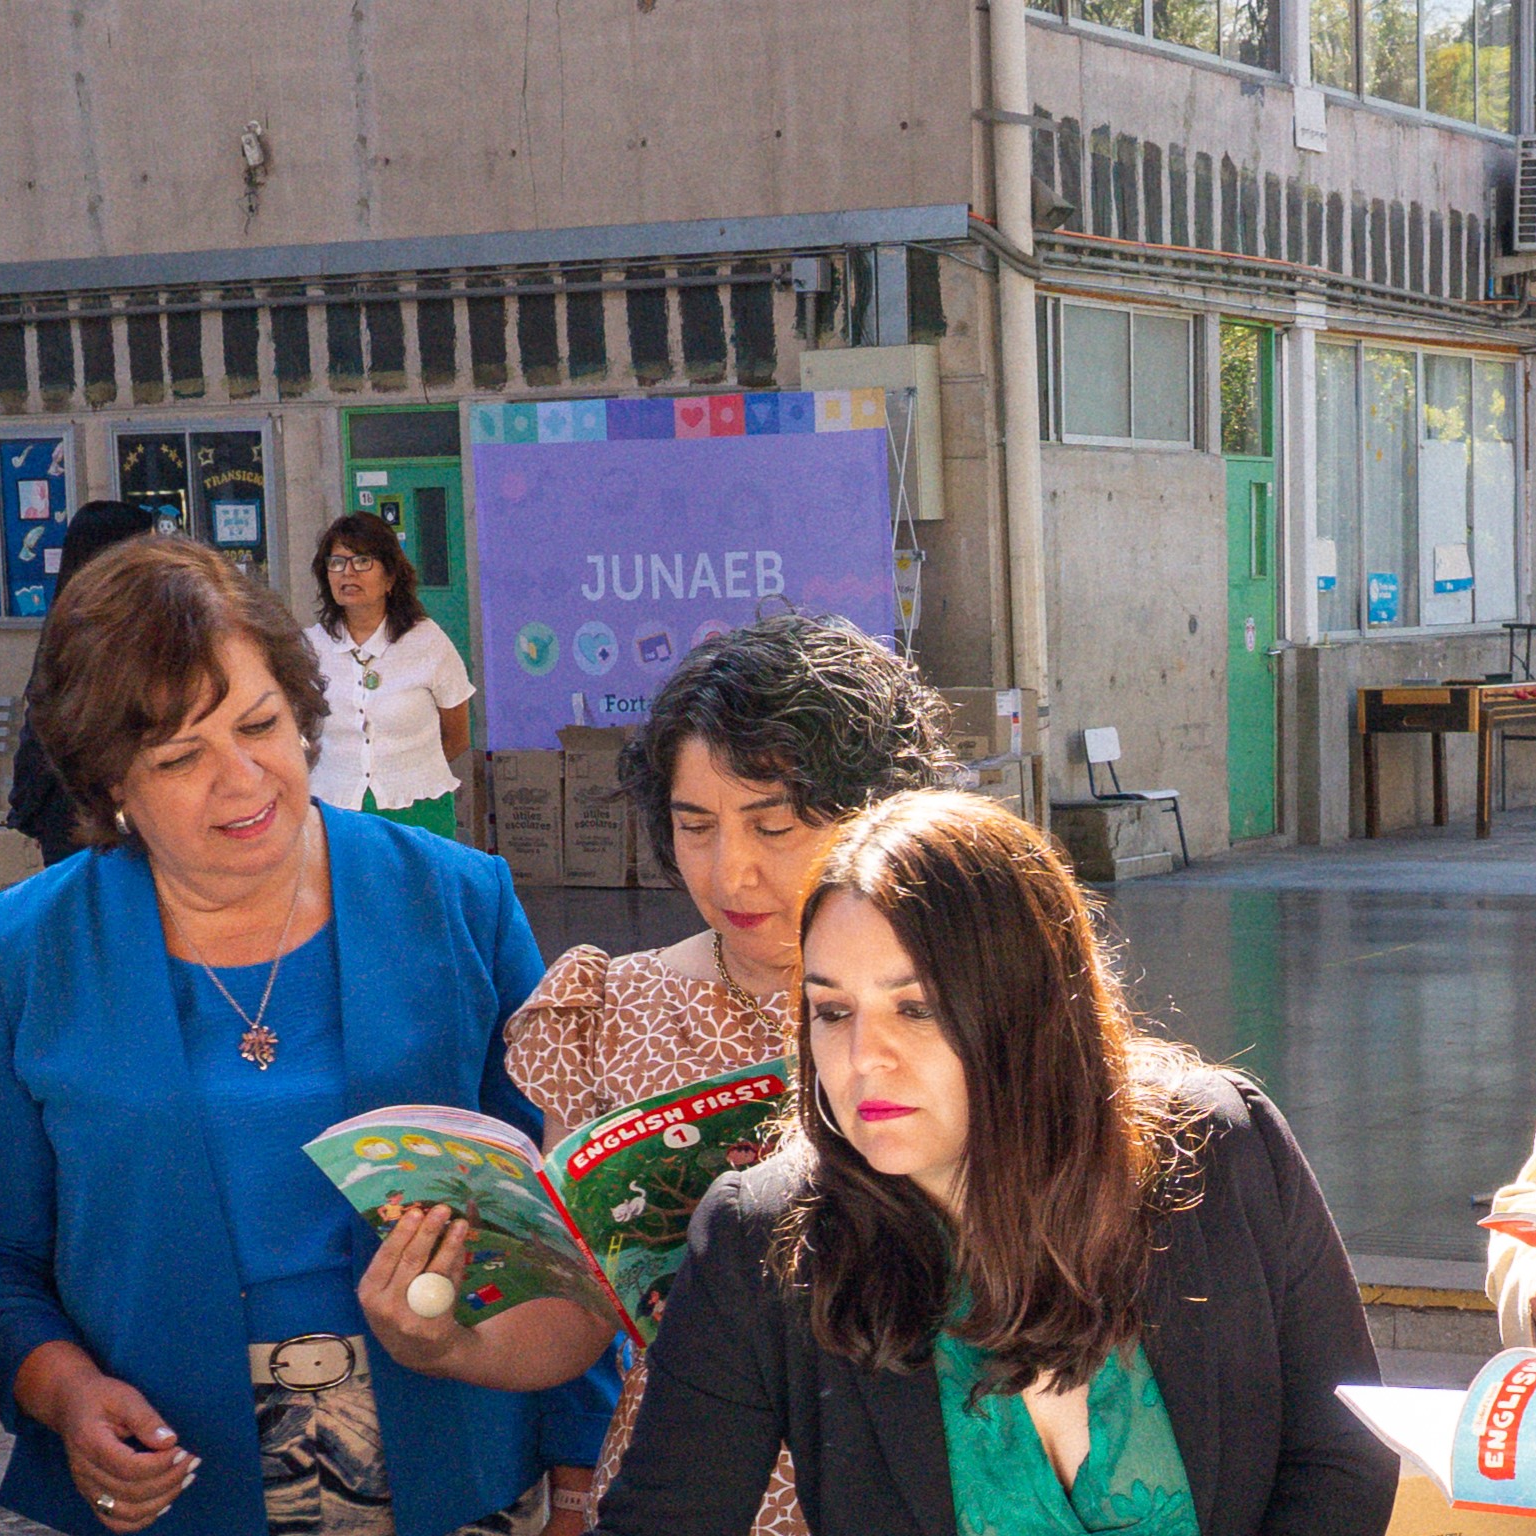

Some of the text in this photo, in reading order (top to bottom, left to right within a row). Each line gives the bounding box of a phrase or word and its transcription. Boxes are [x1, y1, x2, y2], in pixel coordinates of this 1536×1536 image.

[581, 551, 785, 601] JUNAEB
[573, 1107, 685, 1169] ENGLISH
[692, 1079, 771, 1115] FIRST
[672, 1129, 687, 1143] 1
